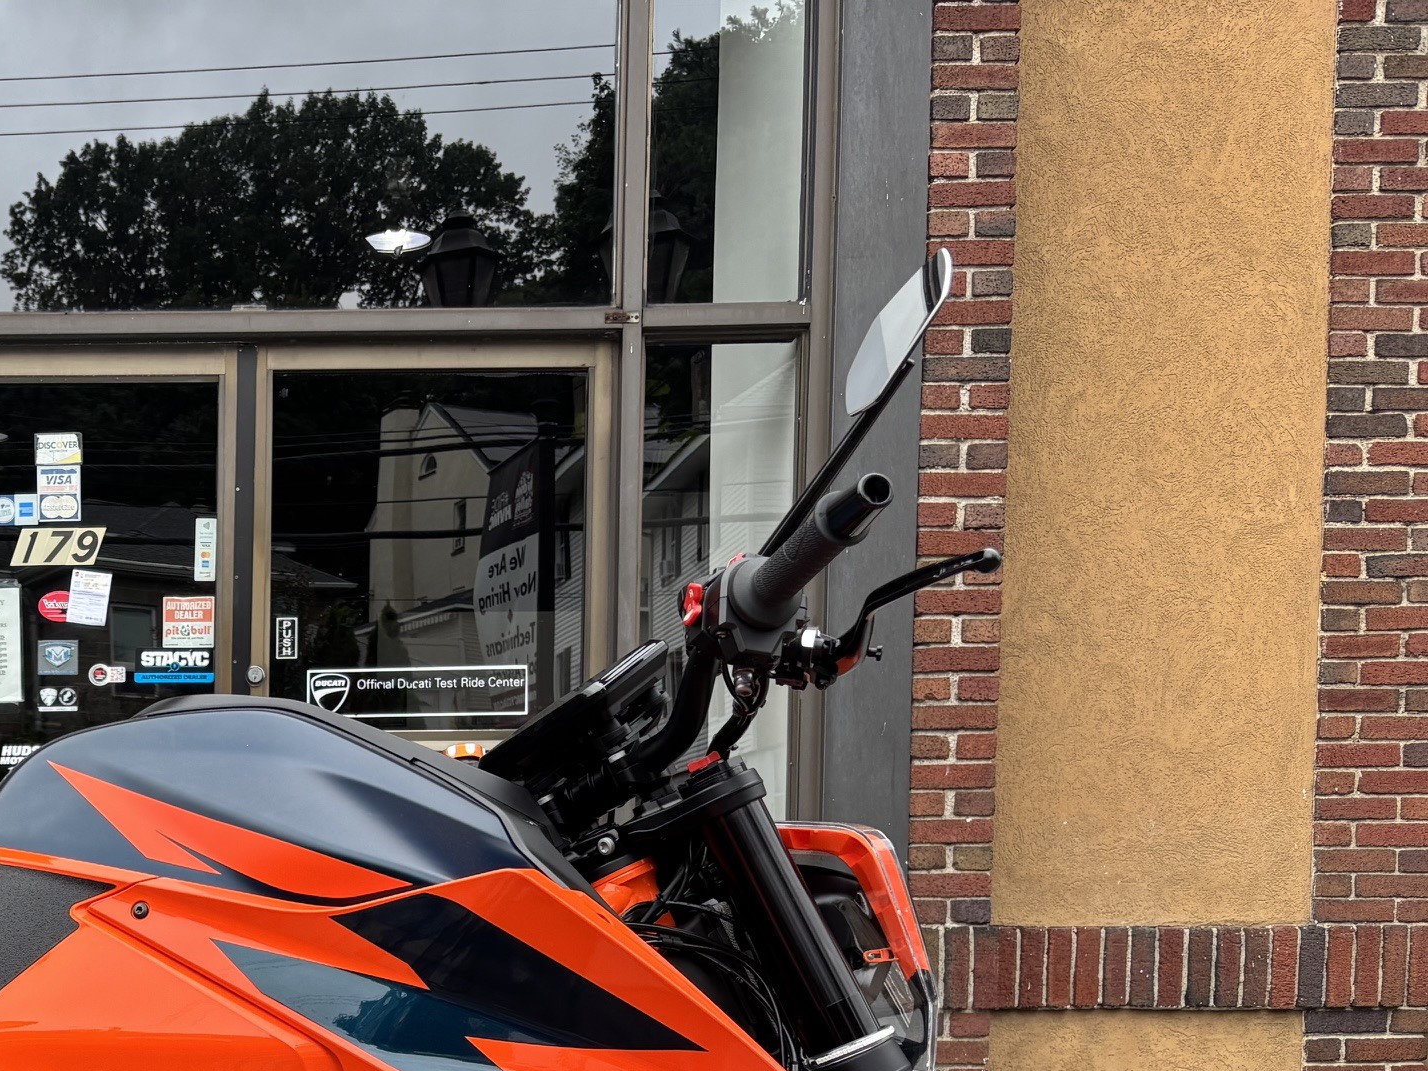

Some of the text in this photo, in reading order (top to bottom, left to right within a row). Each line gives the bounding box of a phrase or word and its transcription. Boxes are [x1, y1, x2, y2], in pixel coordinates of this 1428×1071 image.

[38, 441, 78, 450] DISCOVER
[45, 475, 72, 485] VISA
[22, 530, 99, 564] 179
[166, 601, 212, 610] AUTHORIZED
[174, 610, 204, 619] DEALER
[282, 621, 292, 656] PUSH
[141, 651, 210, 667] STACYC
[315, 679, 346, 688] DUCATI
[357, 677, 525, 690] Official Ducati Test Ride Center
